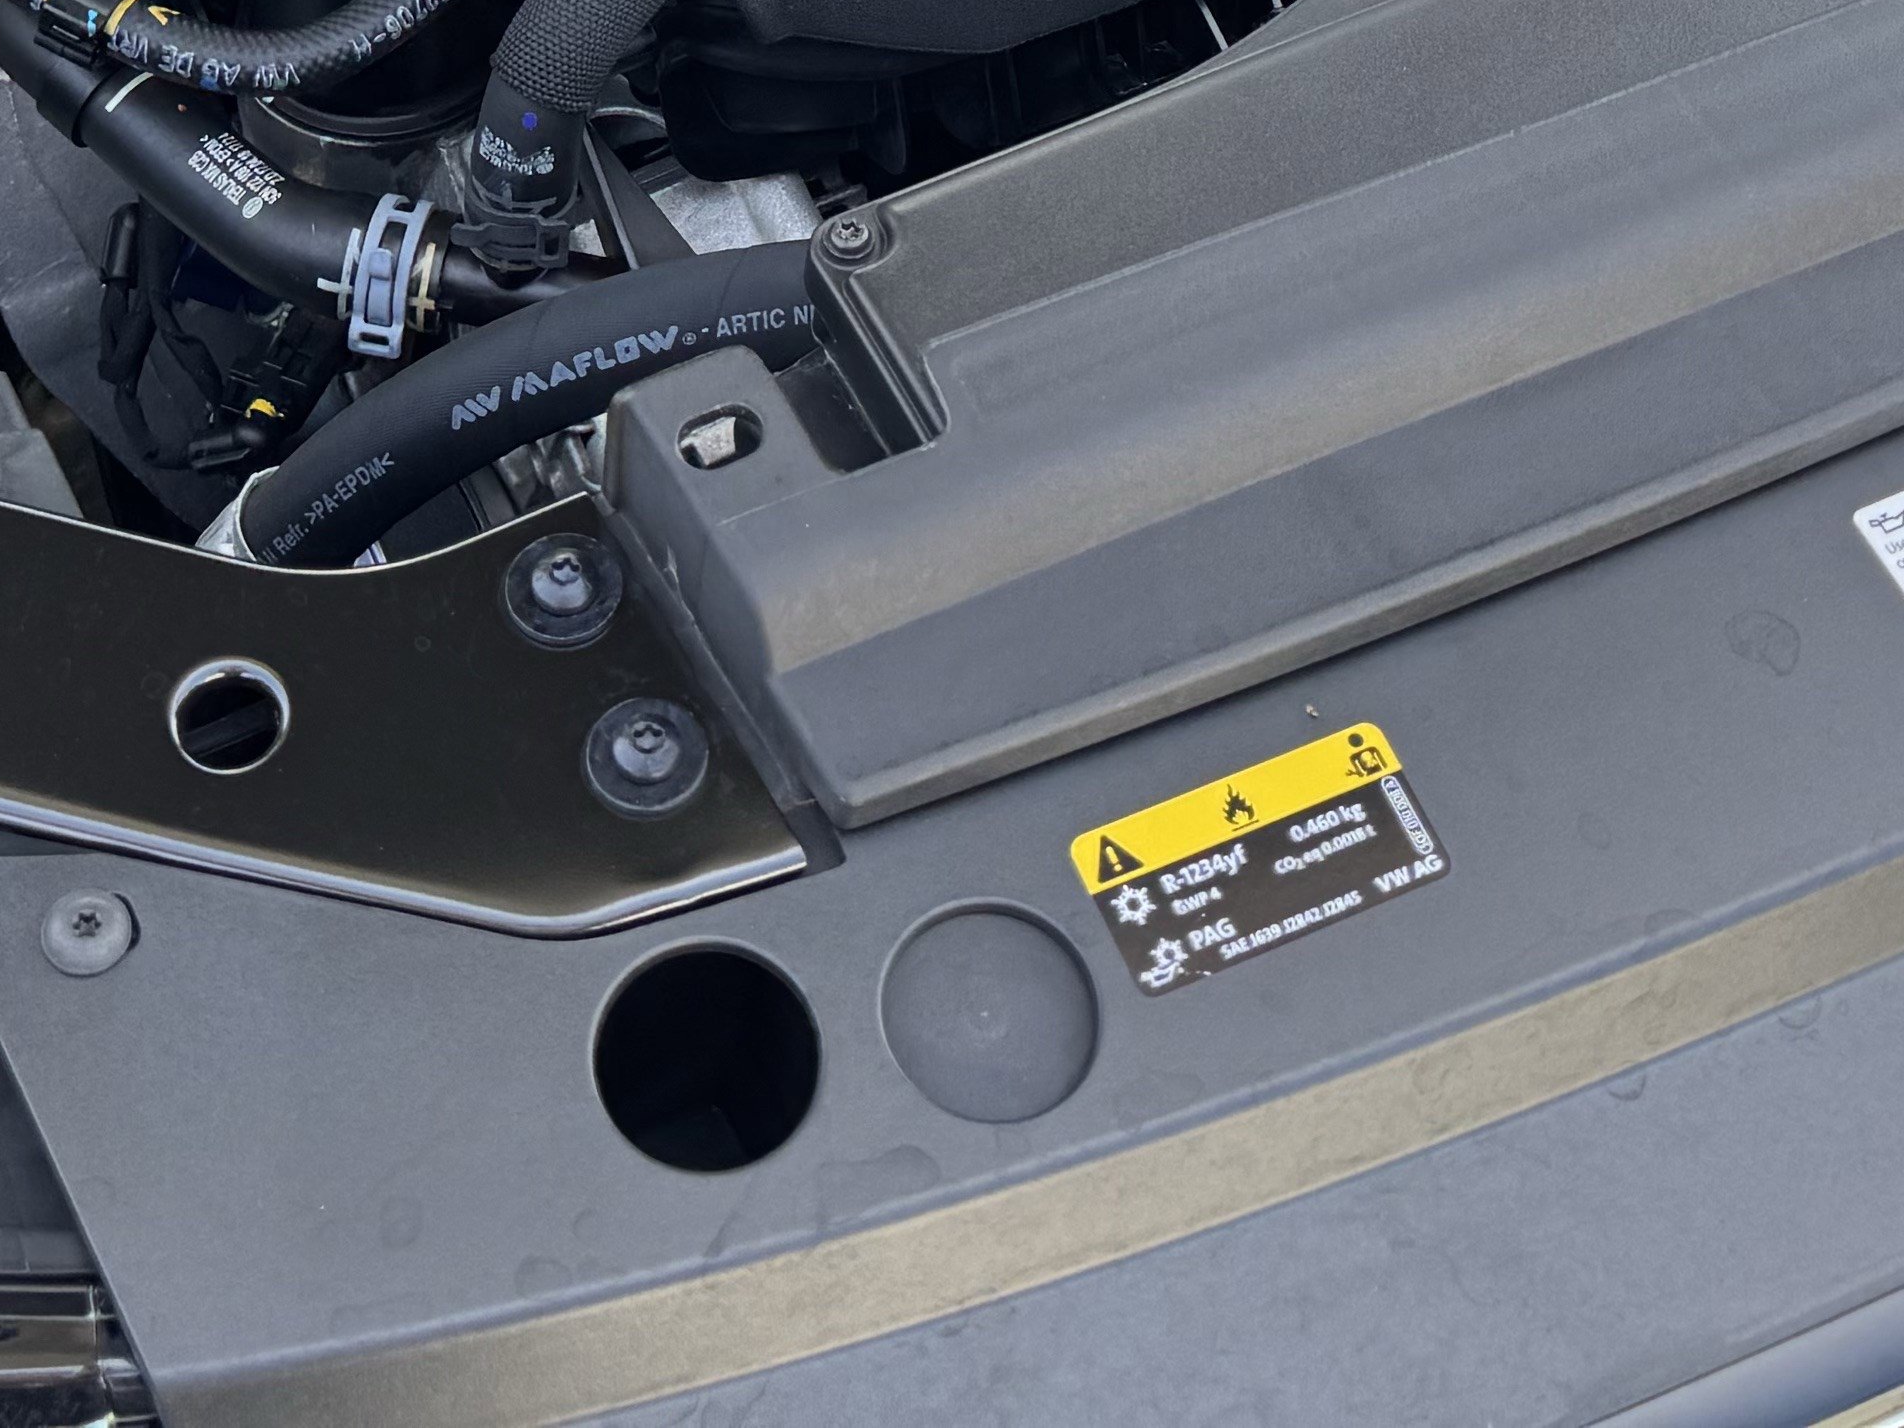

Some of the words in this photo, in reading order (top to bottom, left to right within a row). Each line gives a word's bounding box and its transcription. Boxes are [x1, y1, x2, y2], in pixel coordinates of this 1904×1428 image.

[505, 322, 685, 403] MAFLOW
[713, 307, 787, 337] ARTIC
[269, 516, 313, 556] Refr.
[299, 448, 399, 527] >PA-EPDM<
[1286, 809, 1344, 848] 0.460
[1336, 799, 1369, 827] kg
[1157, 842, 1254, 901] R-1234yf
[1371, 864, 1414, 895] VW
[1406, 850, 1447, 880] AG
[1186, 915, 1238, 952] PAG
[1218, 936, 1252, 961] SAE
